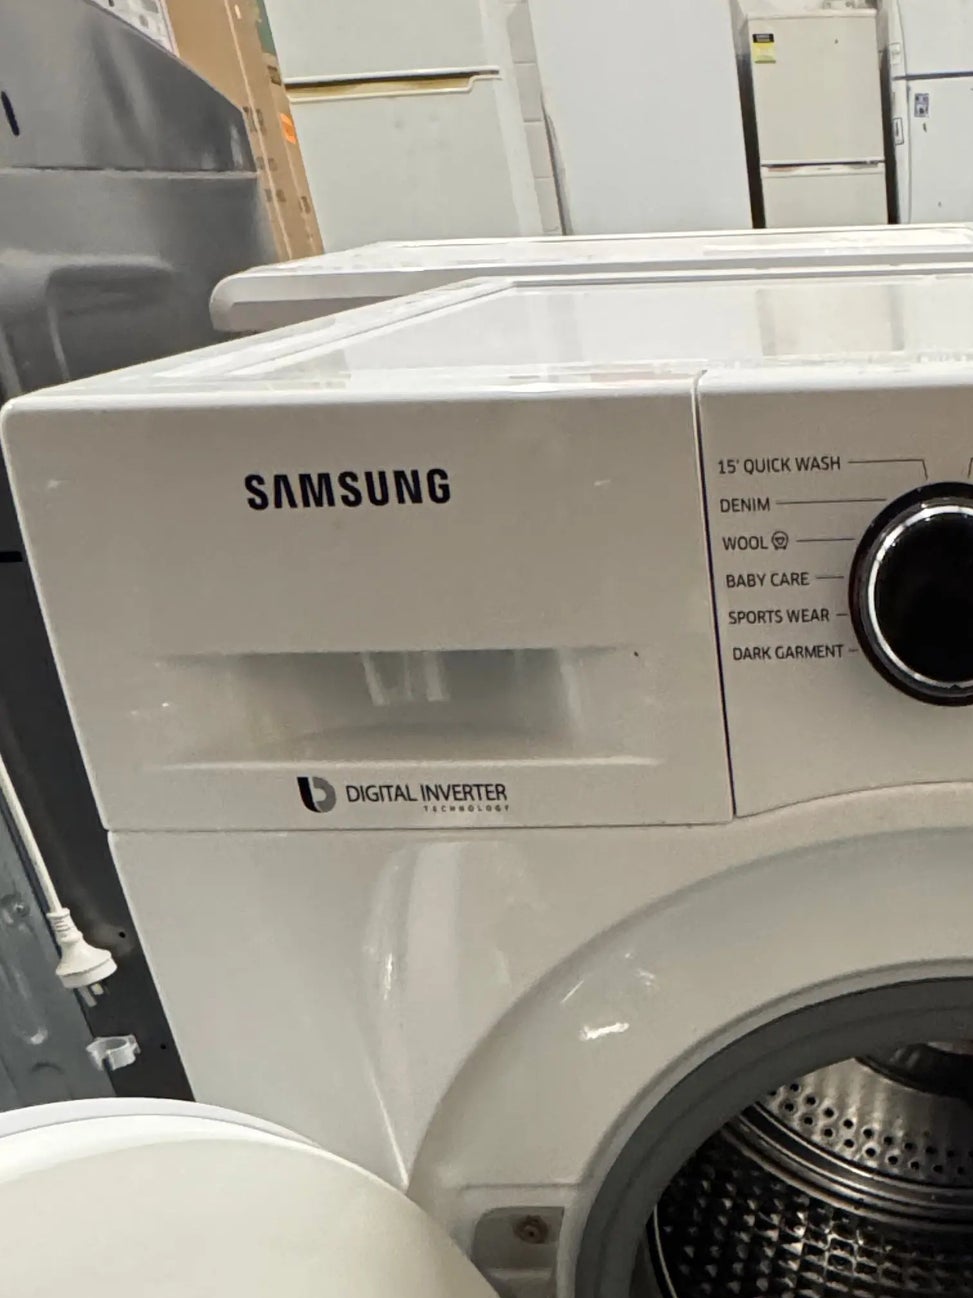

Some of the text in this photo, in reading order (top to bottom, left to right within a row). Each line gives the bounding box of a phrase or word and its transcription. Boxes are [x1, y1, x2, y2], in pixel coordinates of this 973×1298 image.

[718, 455, 841, 474] 15' QUICK WASH
[245, 468, 451, 510] SAMSUNG
[720, 497, 771, 513] DENIM
[723, 535, 769, 551] WOOL
[726, 571, 810, 588] BABY CARE
[728, 608, 830, 625] SPORTS WEAR
[733, 643, 843, 661] DARK GARMENT
[346, 783, 508, 803] DIGITAL INVERTER
[423, 804, 509, 813] TECHNOLOGY
